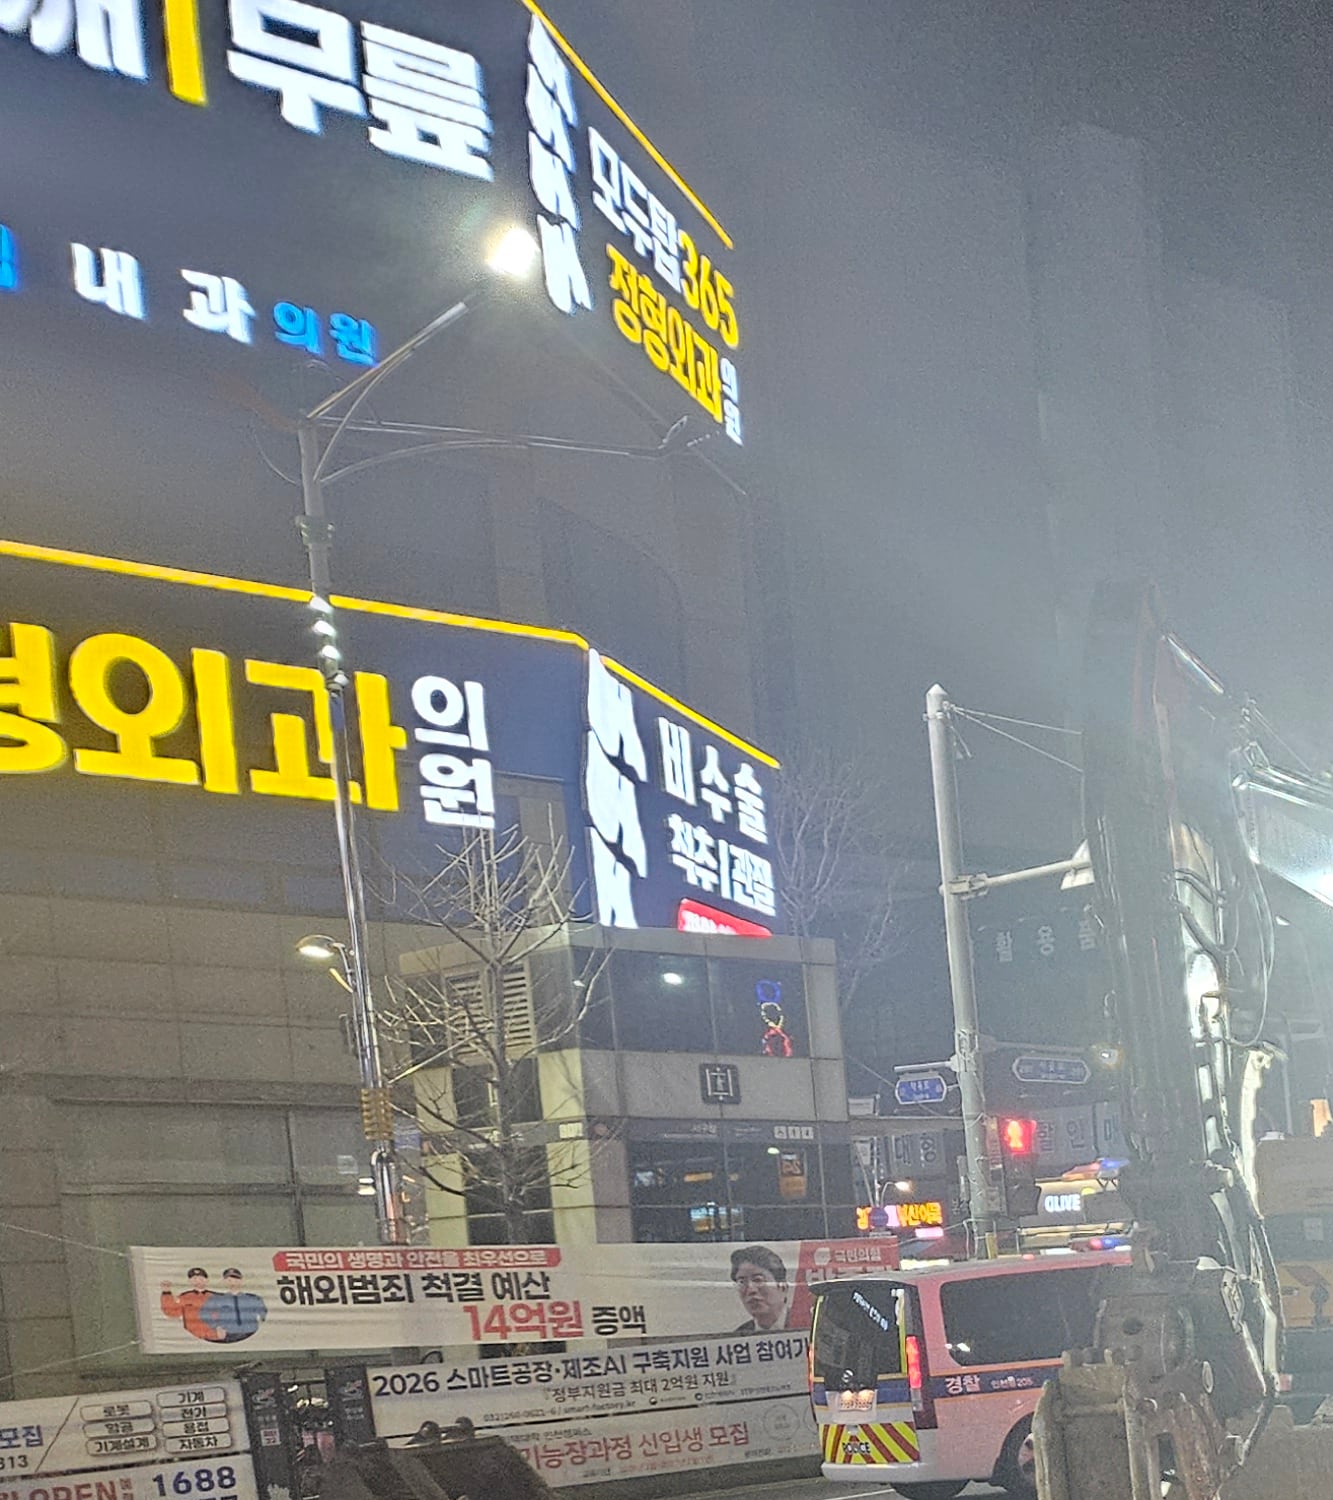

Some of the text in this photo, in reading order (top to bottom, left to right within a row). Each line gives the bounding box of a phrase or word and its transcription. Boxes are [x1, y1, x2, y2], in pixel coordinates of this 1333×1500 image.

[227, 0, 494, 182] 무릎
[273, 301, 379, 368] 의원
[411, 674, 497, 831] 의원
[657, 716, 769, 845] 비수술
[1044, 1193, 1082, 1213] OLIVE
[285, 1249, 549, 1269] 국민의 생명과 안전을 최우선으로
[834, 1246, 882, 1263] 국민의힘
[276, 1270, 551, 1306] 해외범죄 척결 예산
[462, 1300, 648, 1341] 14억원 증액
[372, 1371, 441, 1398] 2026
[632, 1346, 710, 1375] 구축지원
[715, 1342, 751, 1367] 사업
[630, 1378, 658, 1397] 최대
[661, 1375, 699, 1392] 2억원
[944, 1374, 981, 1395] 경찰
[103, 1404, 131, 1417] 로봇
[177, 1391, 205, 1404] 기계
[0, 1424, 44, 1450] 모집
[638, 1428, 704, 1457] 신입생
[708, 1420, 750, 1446] 모집
[152, 1466, 237, 1498] 1688
